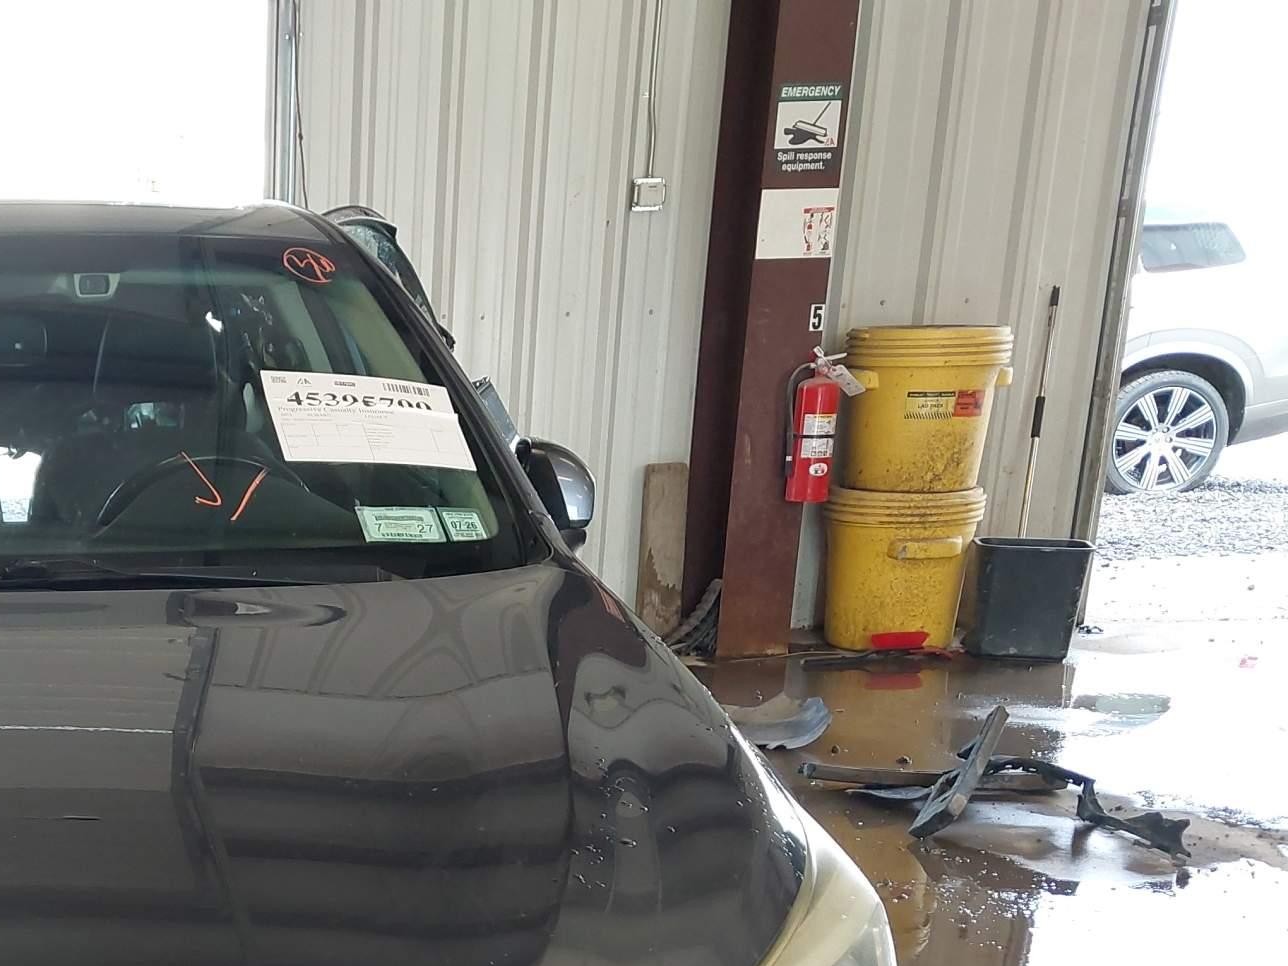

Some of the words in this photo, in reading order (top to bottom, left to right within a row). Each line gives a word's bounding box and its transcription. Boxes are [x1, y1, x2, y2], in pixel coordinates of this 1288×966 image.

[781, 85, 841, 98] EMERGENCY
[777, 152, 795, 162] Spill
[796, 152, 832, 162] response
[781, 161, 825, 172] equipment.
[811, 304, 823, 330] 5
[374, 522, 383, 533] 7
[417, 524, 434, 534] 27
